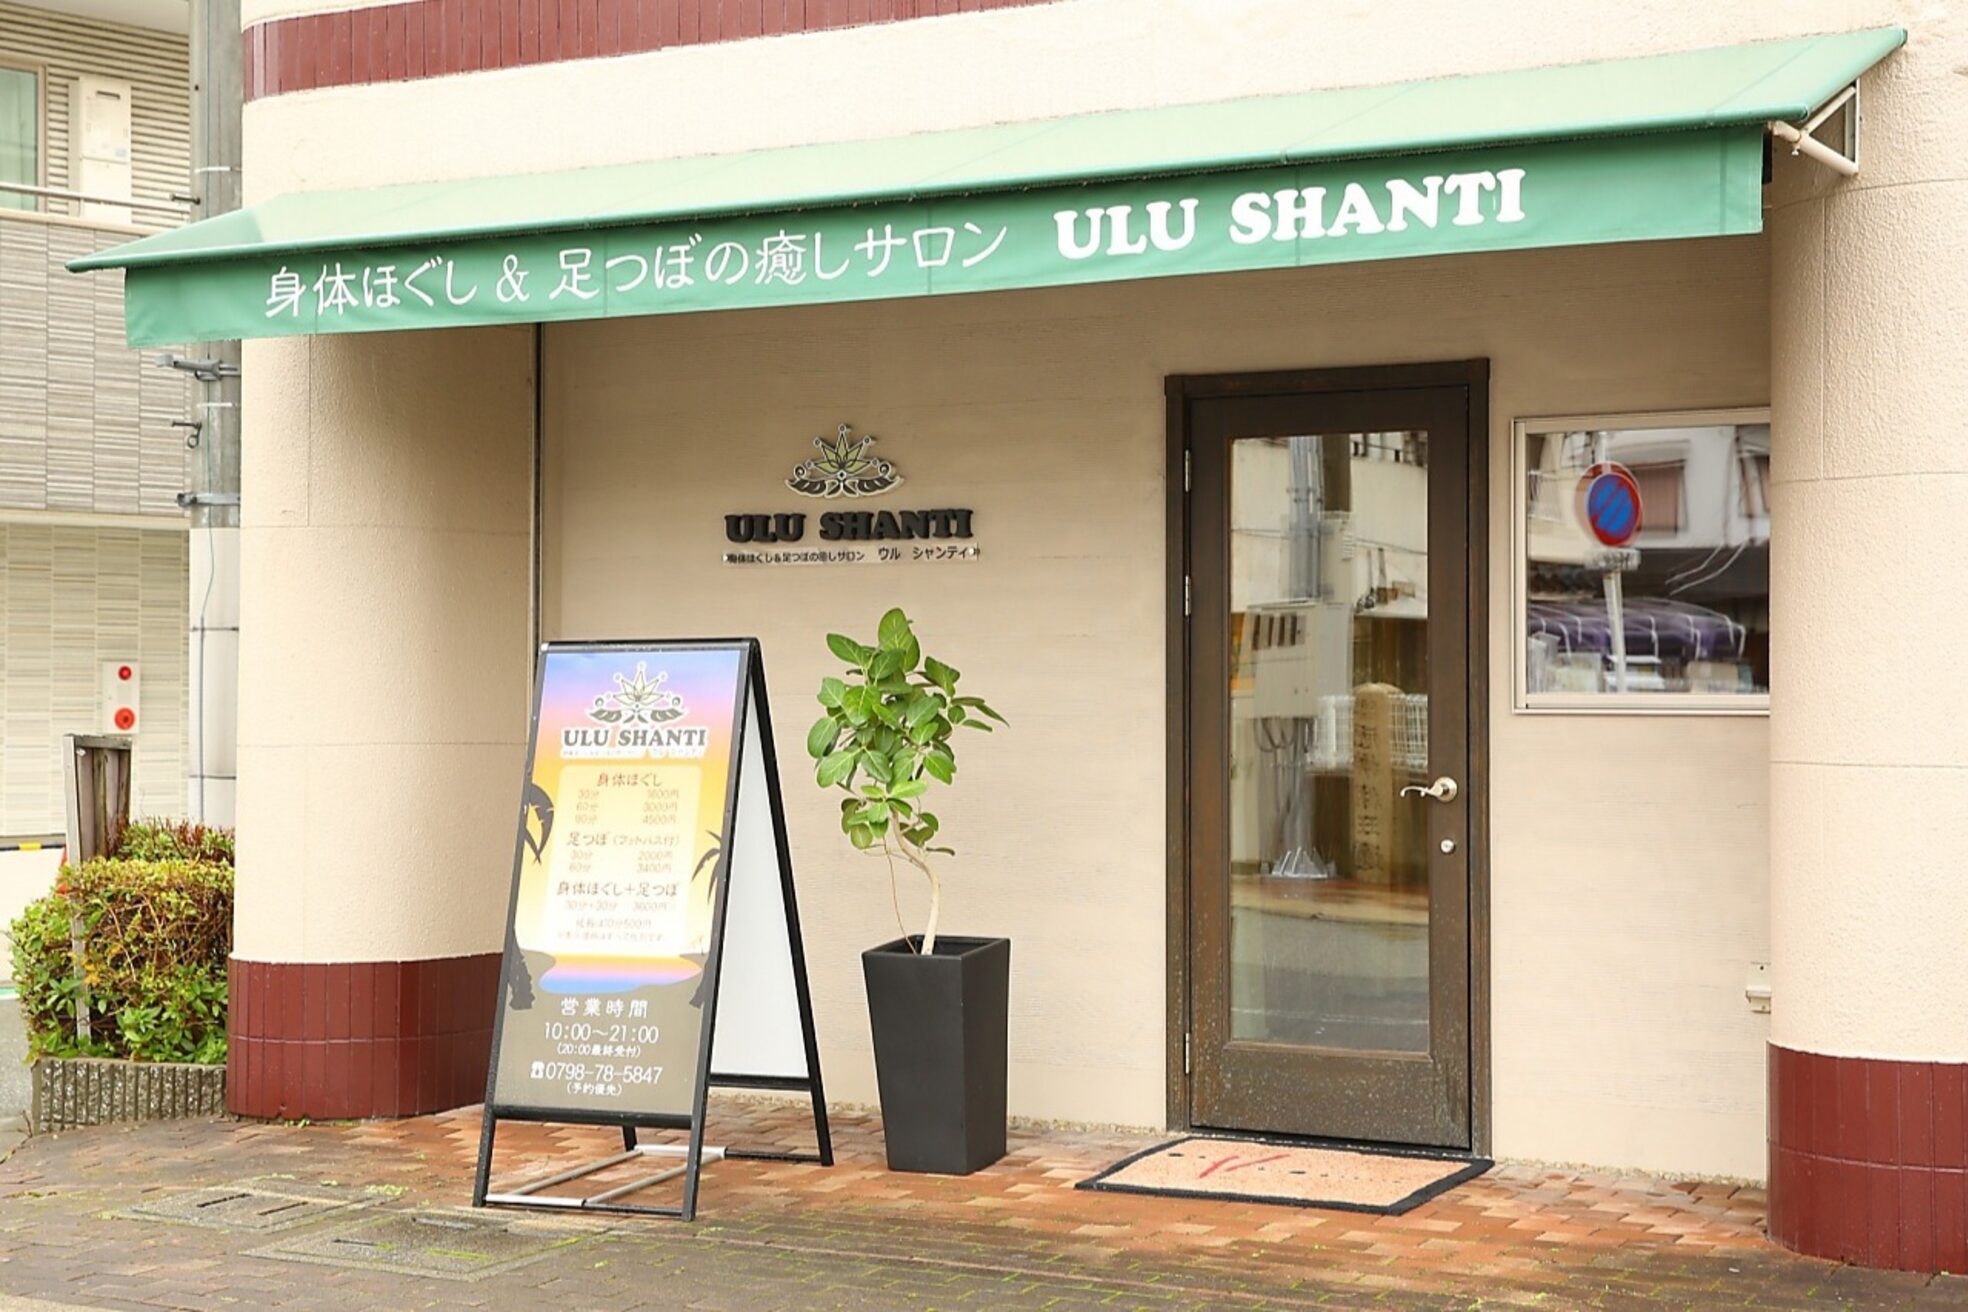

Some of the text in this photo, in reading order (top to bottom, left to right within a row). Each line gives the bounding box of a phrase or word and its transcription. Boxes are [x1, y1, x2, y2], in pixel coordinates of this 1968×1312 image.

[264, 168, 1526, 318] 身体ほぐし & 足つぼの癒しサロン ULU SHANTI
[724, 508, 974, 543] ULU SHANTI
[879, 546, 901, 561] ウル
[912, 545, 968, 560] シャンティ
[563, 728, 707, 747] ULU SHANTI
[597, 772, 664, 788] 身体ほぐし
[566, 831, 610, 847] 足つぼ
[560, 997, 649, 1019] 営業時間
[546, 1061, 663, 1084] 0798-78-5847
